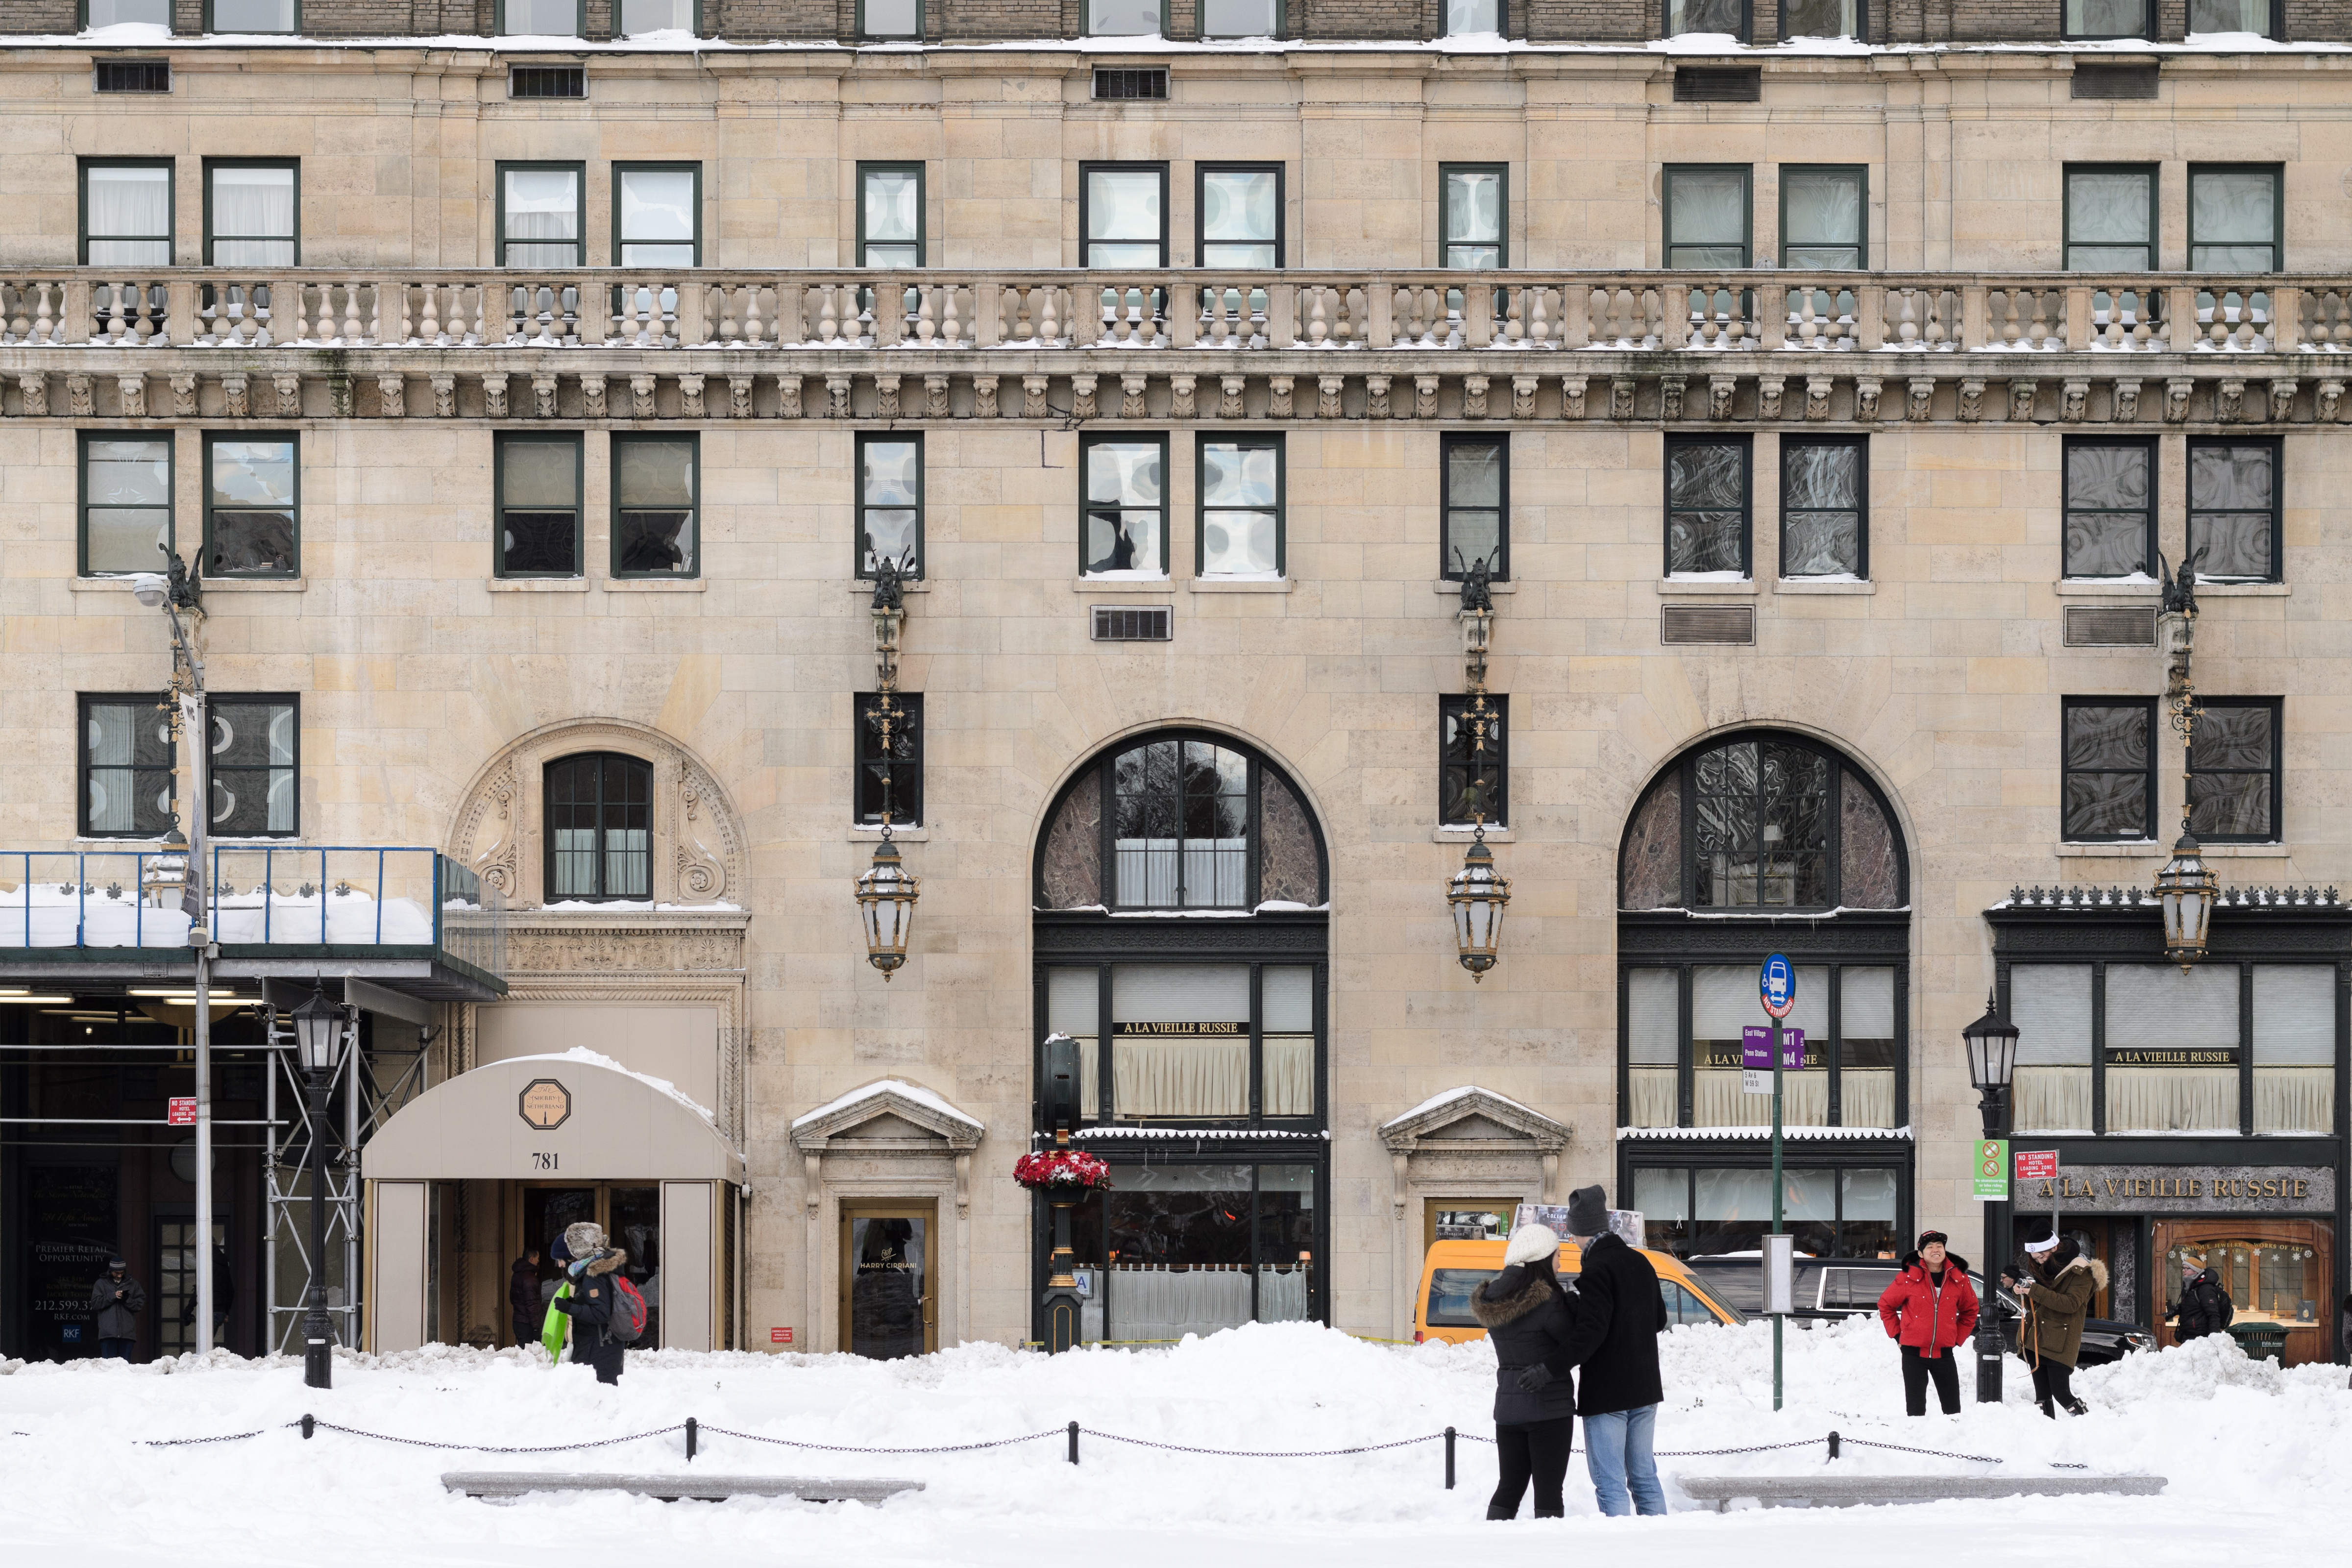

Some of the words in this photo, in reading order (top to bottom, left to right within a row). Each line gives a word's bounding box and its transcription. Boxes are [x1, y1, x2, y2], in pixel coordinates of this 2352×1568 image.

[1764, 996, 1771, 1008] NO
[1770, 999, 1793, 1016] STANDING
[1124, 1023, 1133, 1032] A
[1135, 1023, 1150, 1032] LA
[1152, 1023, 1196, 1033] VIEILLE
[1199, 1023, 1238, 1033] RUSSIE
[1754, 1029, 1766, 1038] Village
[1783, 1031, 1795, 1046] M1
[1704, 1054, 1712, 1064] A
[1715, 1054, 1729, 1064] LA
[1783, 1052, 1795, 1066] M4
[2115, 1052, 2123, 1061] A
[2126, 1052, 2141, 1062] LA
[2142, 1052, 2186, 1062] VIEILLE
[2190, 1052, 2230, 1062] RUSSIE
[532, 1152, 560, 1170] 781
[2038, 1179, 2054, 1197] A
[2062, 1179, 2095, 1197] LA
[2104, 1179, 2203, 1197] VIEILLE
[2212, 1179, 2308, 1197] RUSSIE
[36, 1245, 74, 1253] PREMIER
[2181, 1244, 2210, 1252] ANTIQUE
[39, 1253, 104, 1262] OPPORTUNITY
[1077, 1276, 1087, 1289] A
[35, 1300, 92, 1311] 212.599.37
[64, 1329, 80, 1338] RKF
